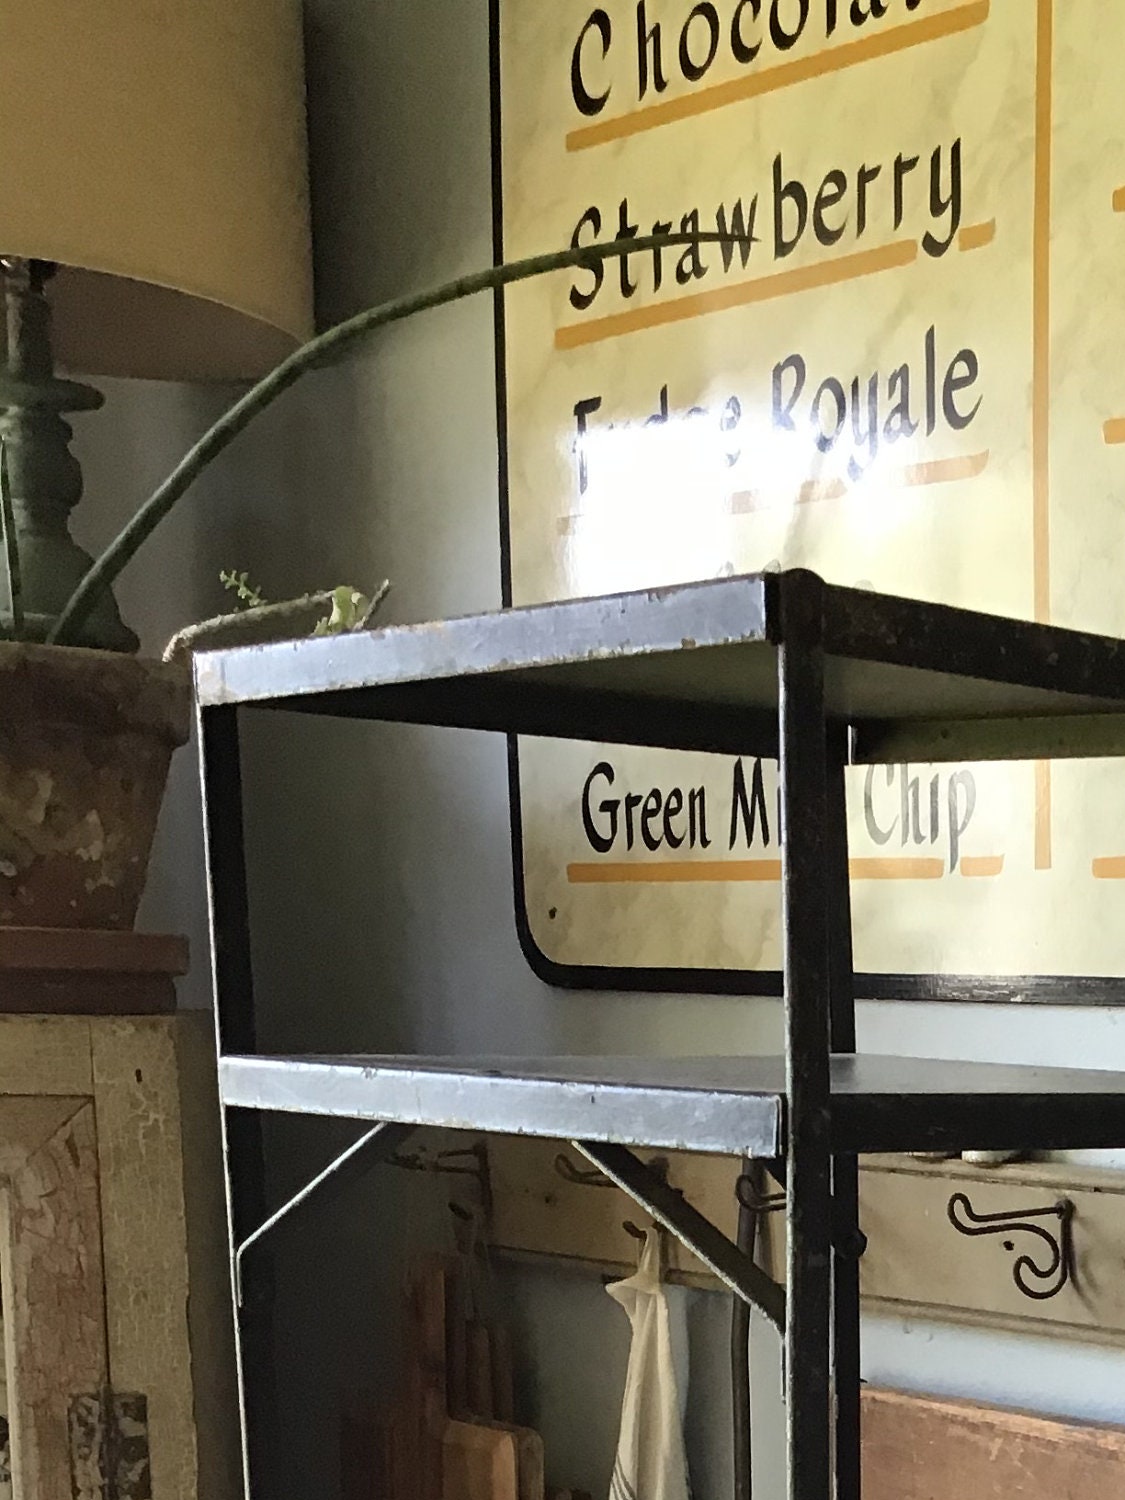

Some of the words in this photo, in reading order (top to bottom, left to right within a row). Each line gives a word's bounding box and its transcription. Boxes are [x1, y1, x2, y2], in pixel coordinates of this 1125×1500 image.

[571, 0, 922, 117] Choco
[569, 137, 962, 311] Strawberry
[771, 324, 984, 482] Royale
[581, 761, 713, 854] Green
[864, 763, 977, 874] Chip
